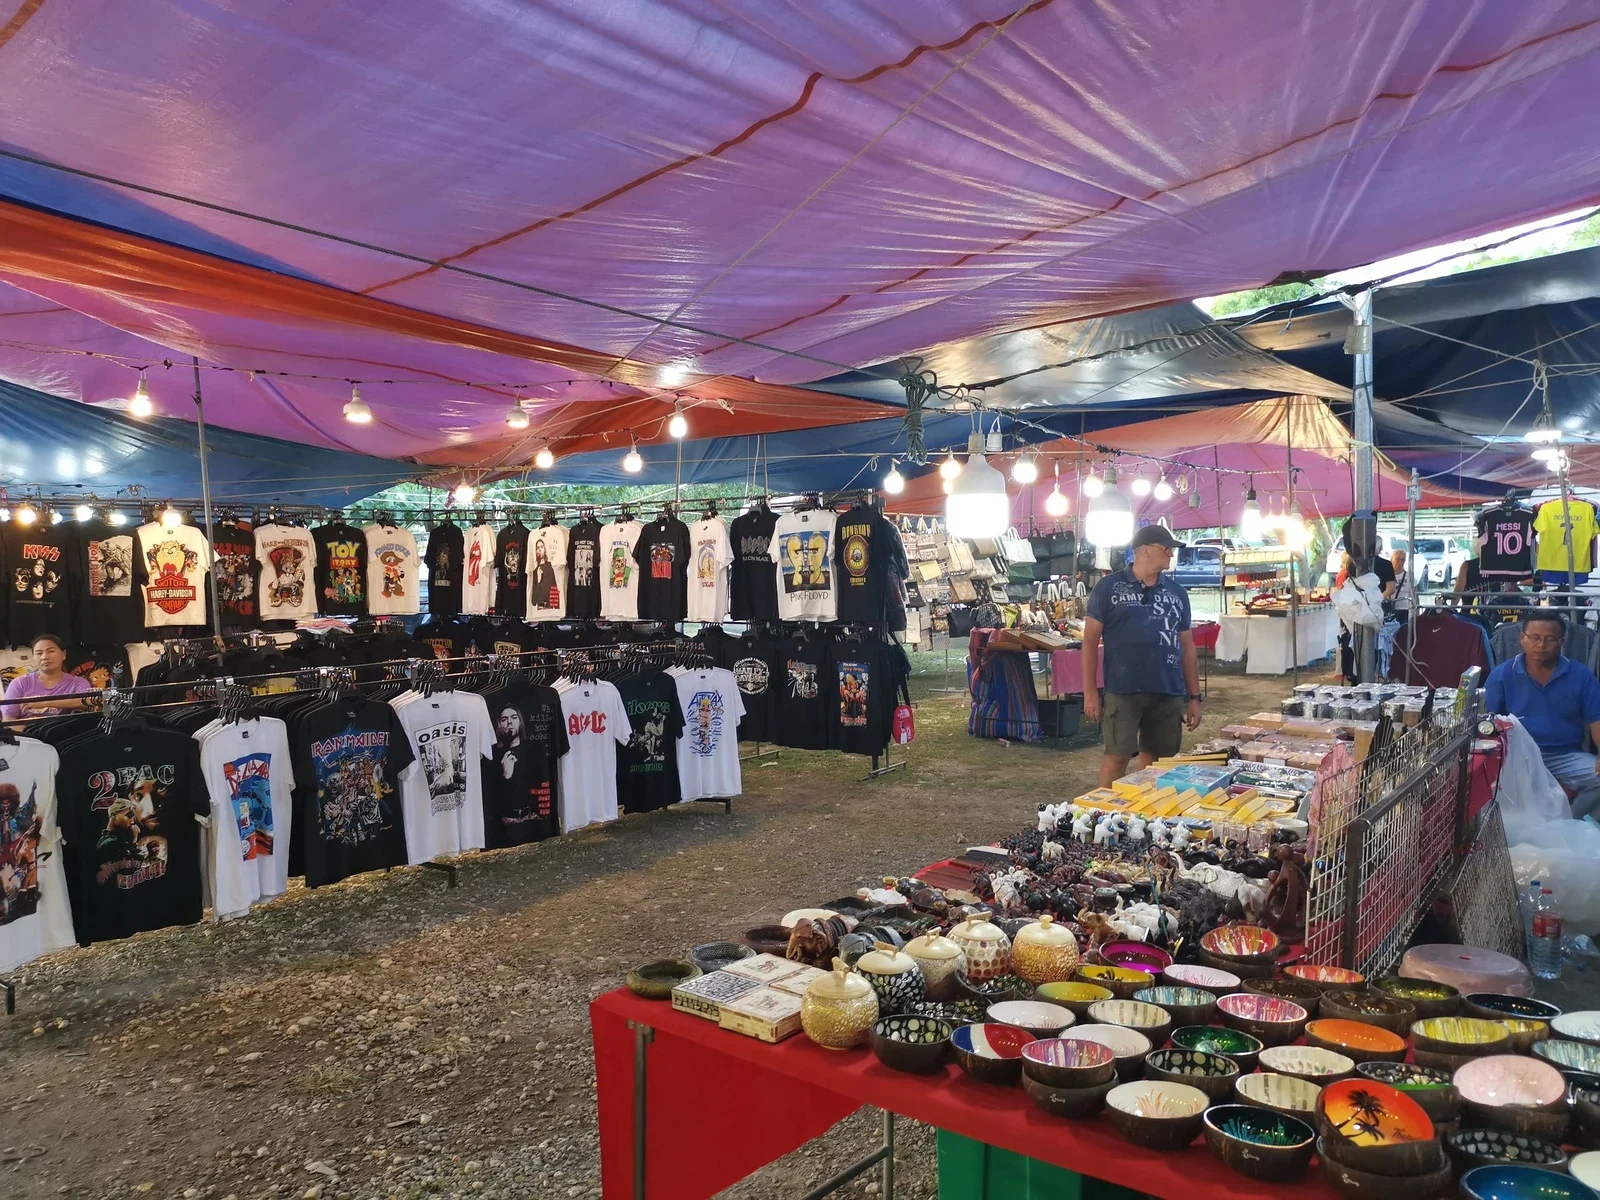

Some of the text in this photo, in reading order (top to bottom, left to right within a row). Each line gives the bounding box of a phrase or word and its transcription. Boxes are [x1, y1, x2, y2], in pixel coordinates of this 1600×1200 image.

[1496, 522, 1521, 531] MESSI
[327, 540, 362, 557] TOY
[1494, 531, 1523, 555] 10
[23, 544, 61, 562] KISS
[804, 591, 829, 601] FLOYD
[418, 722, 467, 744] oasis
[310, 738, 343, 759] IRON
[87, 764, 176, 812] 2PAC
